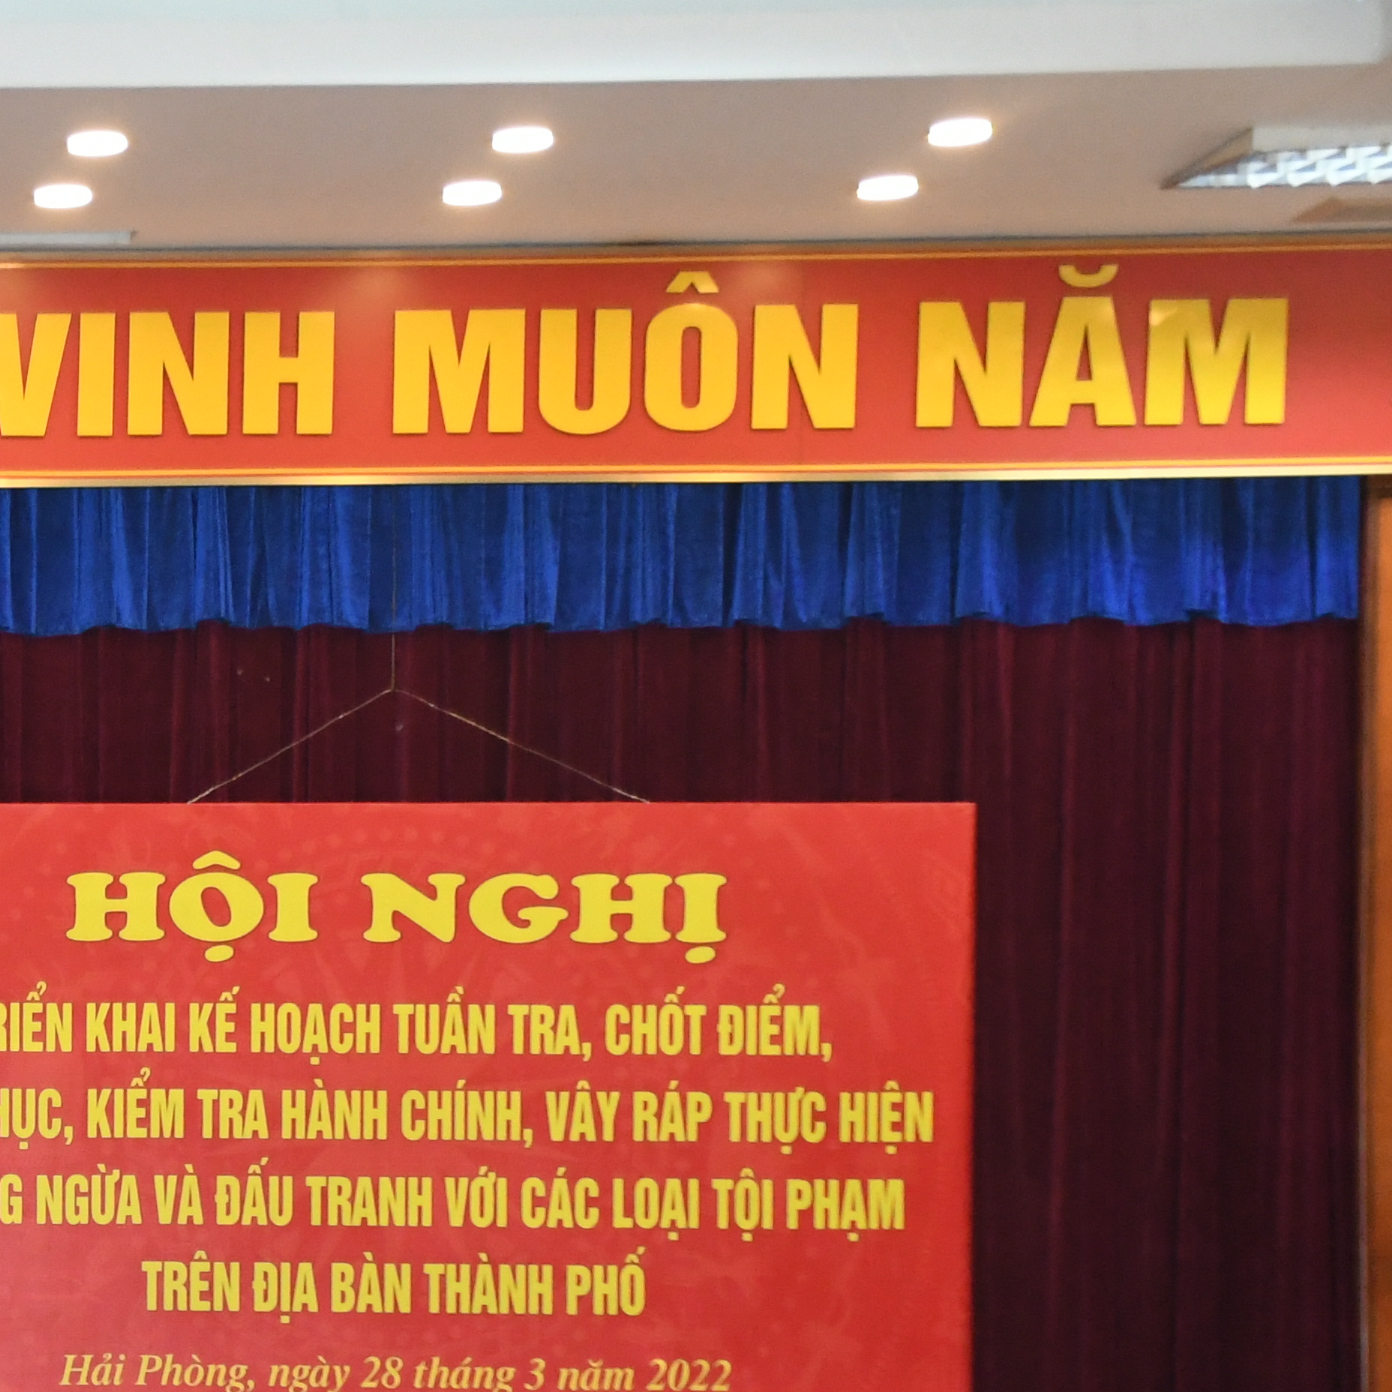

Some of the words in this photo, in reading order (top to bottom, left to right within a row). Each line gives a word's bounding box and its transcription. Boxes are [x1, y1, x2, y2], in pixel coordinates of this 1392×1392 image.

[392, 270, 859, 436] MUÔN
[915, 263, 1289, 429] NĂM
[65, 850, 319, 963] HỘI
[361, 872, 727, 964] NGHỊ
[86, 1002, 176, 1053] KHAI
[189, 985, 240, 1053] KẾ
[250, 1002, 381, 1066] HOẠCH
[392, 985, 496, 1055] TUẦN
[507, 1004, 592, 1062] TRA,
[605, 985, 707, 1056] CHỐT
[717, 983, 832, 1062] ĐIỂM,
[87, 1066, 185, 1139] KIỂM
[196, 1088, 269, 1140] TRA
[281, 1078, 388, 1140] HÀNH
[401, 1079, 533, 1148] CHÍNH,
[545, 1079, 621, 1142] VÂY
[633, 1080, 713, 1142] RÁP
[724, 1086, 826, 1155] THỰC
[839, 1080, 934, 1155] HIỆN
[36, 1163, 143, 1226] NGỪA
[153, 1163, 204, 1225] VÀ
[214, 1156, 294, 1227] ĐẤU
[305, 1175, 433, 1228] TRANH
[444, 1165, 508, 1228] VỚI
[521, 1166, 600, 1229] CÁC
[612, 1177, 700, 1241] LOẠI
[711, 1167, 773, 1242] TỘI
[786, 1178, 905, 1242] PHẠM
[141, 1250, 241, 1312] TRÊN
[252, 1261, 319, 1324] ĐỊA
[331, 1251, 412, 1314] BÀN
[423, 1252, 553, 1315] THÀNH
[566, 1246, 645, 1316] PHỐ
[59, 1352, 126, 1387] Hải
[360, 1355, 404, 1389] 28
[524, 1357, 546, 1391] 3
[557, 1358, 635, 1391] năm
[645, 1358, 732, 1392] 2022
